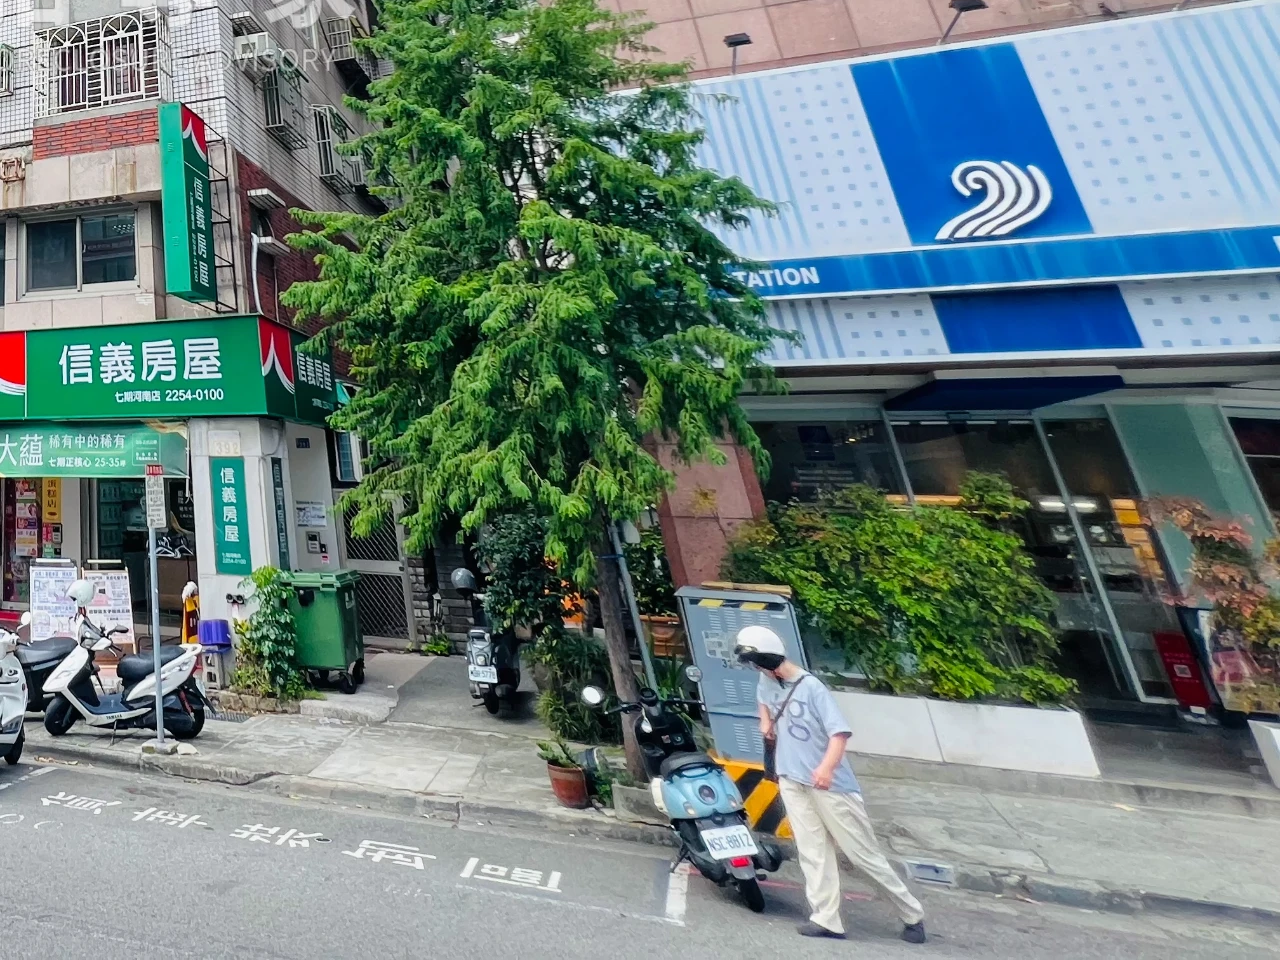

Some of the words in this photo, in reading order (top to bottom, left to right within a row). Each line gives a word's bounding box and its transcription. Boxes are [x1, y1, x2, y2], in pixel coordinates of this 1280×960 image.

[194, 176, 210, 288] 信義房屋
[730, 266, 820, 288] TATION
[59, 337, 223, 386] 信義房屋
[115, 390, 161, 402] 七期河南店
[165, 389, 224, 401] 2254-0100
[48, 434, 125, 449] 稀有中的稀有
[48, 457, 91, 468] 七期正核心
[220, 467, 240, 542] 信義房屋
